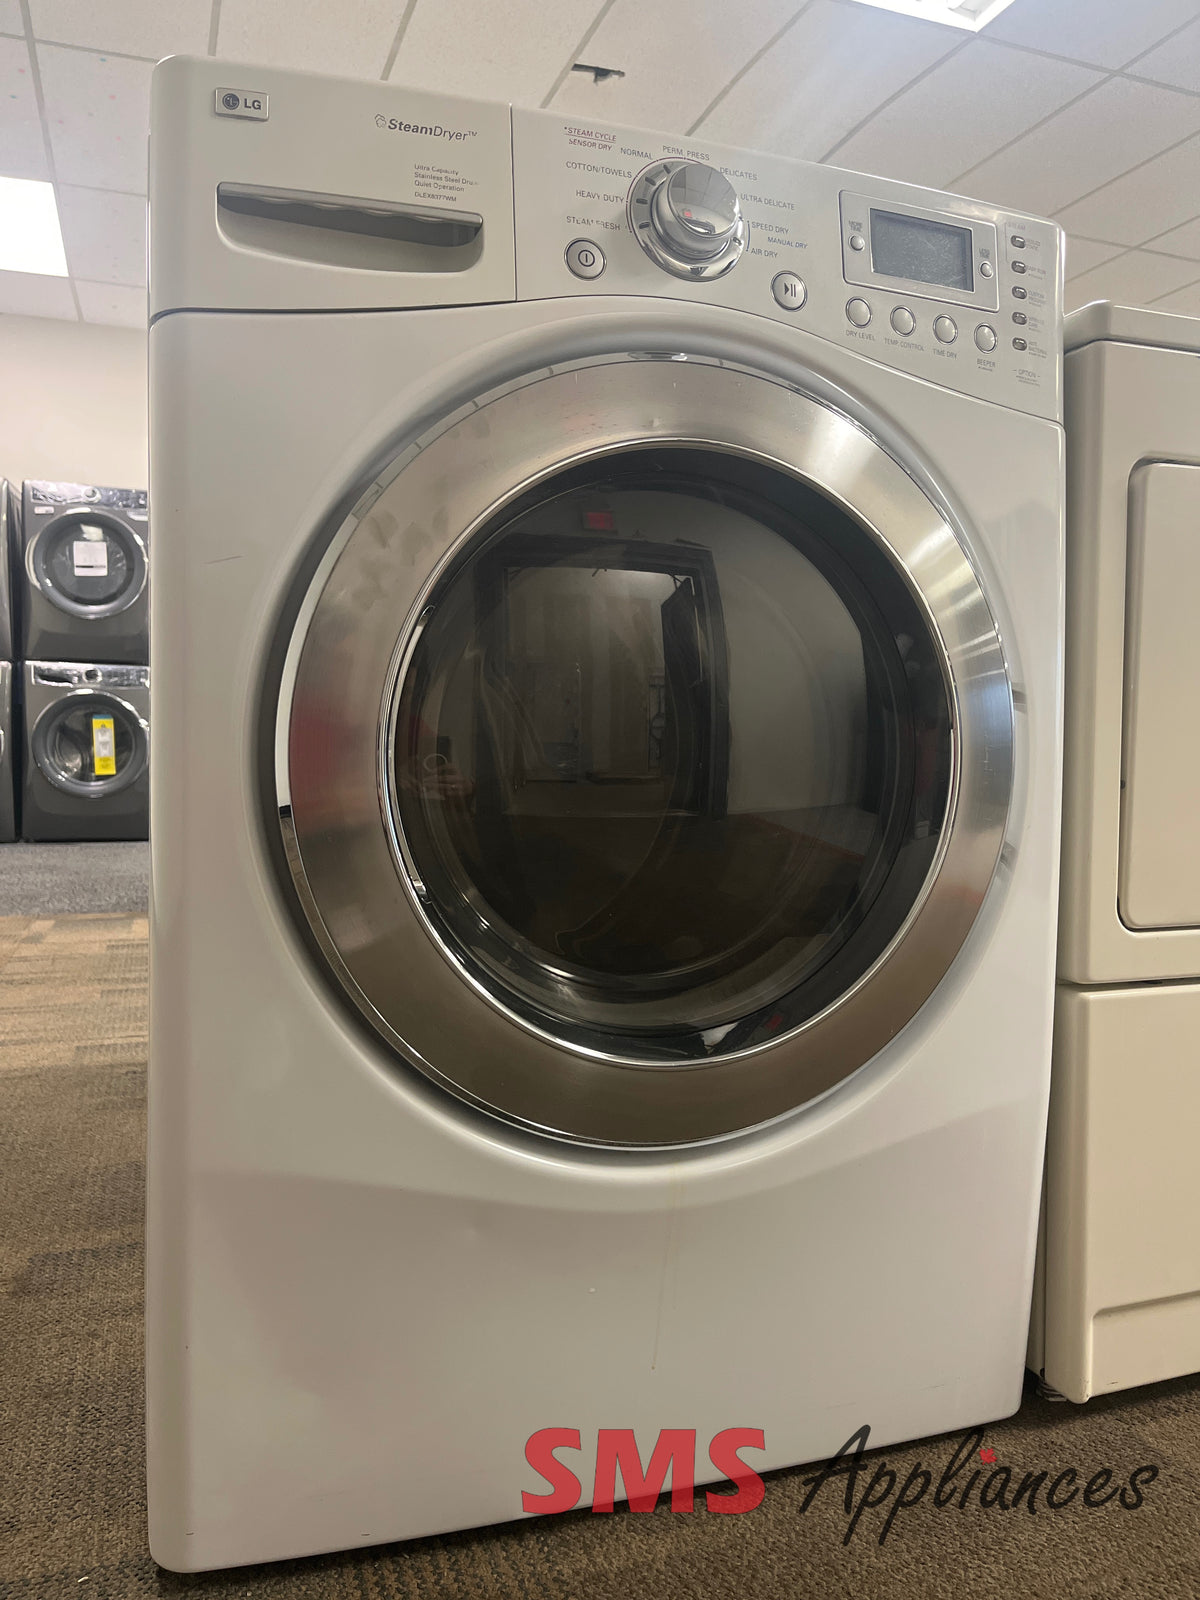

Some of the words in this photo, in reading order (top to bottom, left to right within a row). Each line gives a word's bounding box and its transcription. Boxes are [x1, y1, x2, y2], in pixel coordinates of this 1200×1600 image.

[244, 98, 262, 110] LG
[567, 127, 593, 137] STEAM
[594, 132, 617, 141] CYCLE
[568, 138, 597, 149] SENSOR
[598, 143, 613, 151] DRY
[620, 147, 653, 160] NORMAL
[686, 150, 710, 161] PRESS
[414, 172, 443, 181] Stainless
[444, 175, 461, 184] Steel
[719, 166, 758, 181] DELICATES
[414, 180, 432, 188] Quiet
[433, 182, 465, 192] Operation
[576, 189, 600, 200] HEAVY
[603, 193, 625, 204] DUTY
[740, 194, 763, 204] ULTRA
[763, 198, 796, 211] DELICATE
[751, 221, 774, 232] SPEED
[775, 225, 789, 235] DRY
[767, 236, 795, 248] MANUAL
[795, 241, 808, 249] DRY
[751, 247, 763, 256] AIR
[764, 250, 778, 259] DRY
[845, 329, 858, 337] DRY
[858, 332, 876, 341] LEVEL
[900, 341, 925, 352] CONTROL
[933, 348, 946, 357] TIME
[946, 351, 958, 360] DRY
[976, 358, 996, 368] BEEPER
